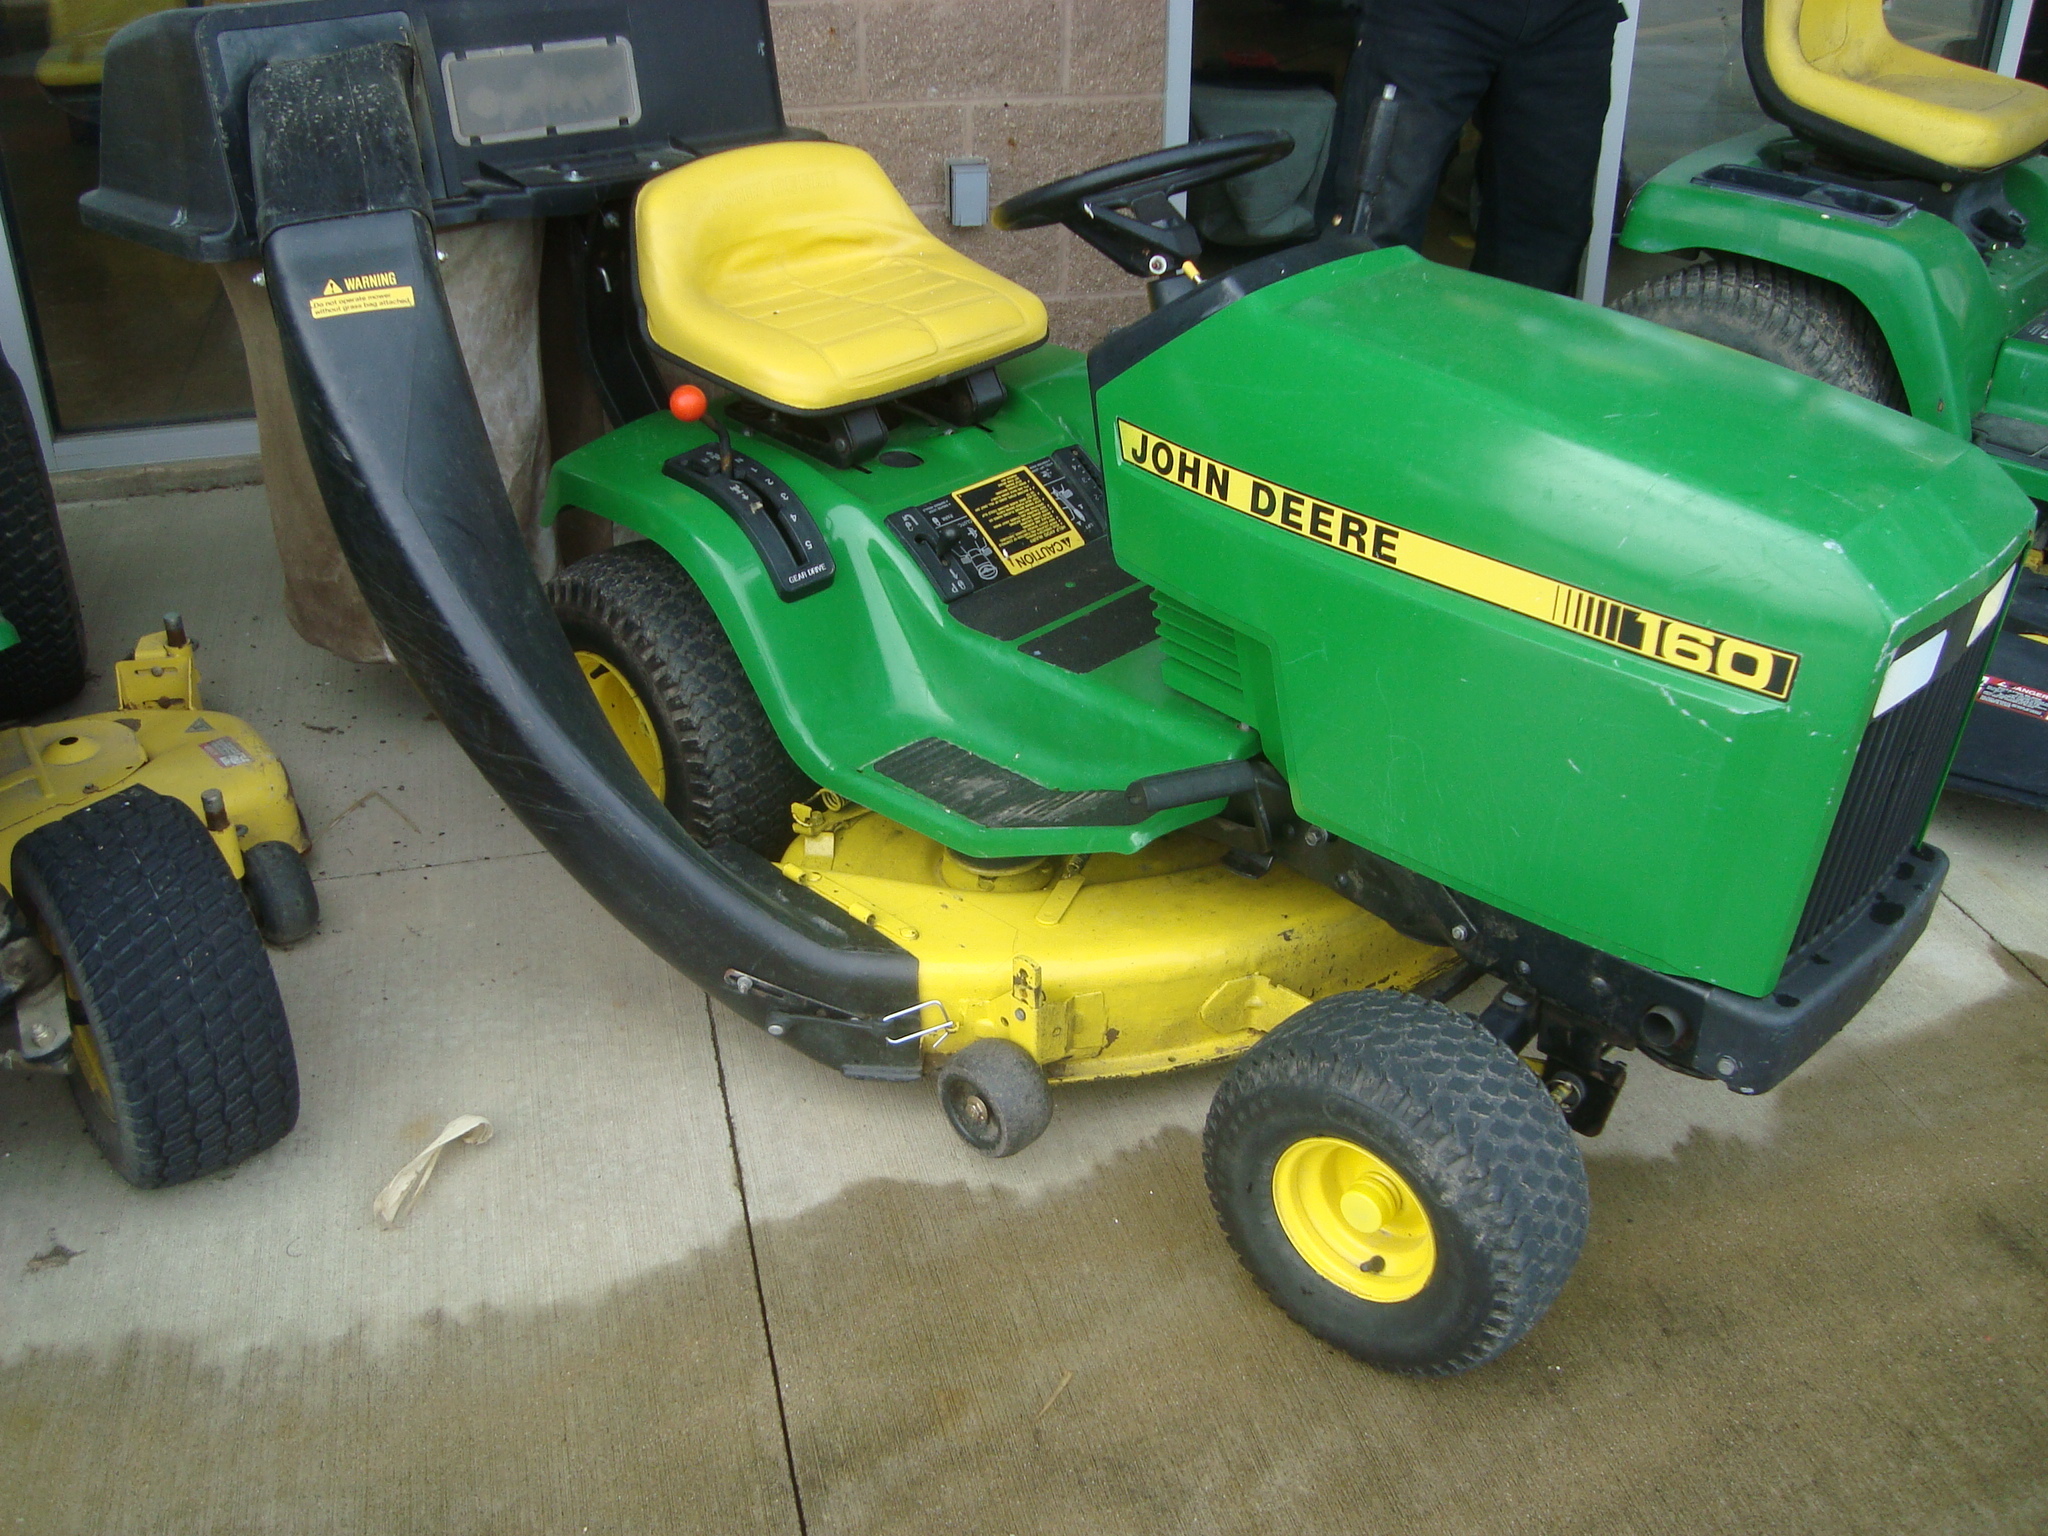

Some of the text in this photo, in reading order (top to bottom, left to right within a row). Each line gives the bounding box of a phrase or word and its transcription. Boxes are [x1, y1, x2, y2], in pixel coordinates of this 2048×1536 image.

[344, 271, 398, 291] WARNING
[325, 299, 338, 307] not
[338, 296, 367, 305] operate
[367, 293, 391, 301] mower
[314, 305, 342, 315] without
[343, 304, 363, 312] grass
[363, 301, 378, 309] bag
[764, 478, 774, 486] 2
[780, 492, 789, 501] 3
[1131, 433, 1400, 565] JOHN DEERE
[789, 513, 798, 522] 4
[804, 540, 813, 550] 5
[1015, 541, 1063, 568] CAUTION
[788, 562, 827, 584] GEAR DRIVE
[1636, 611, 1774, 690] 160
[2011, 686, 2048, 700] ANGER
